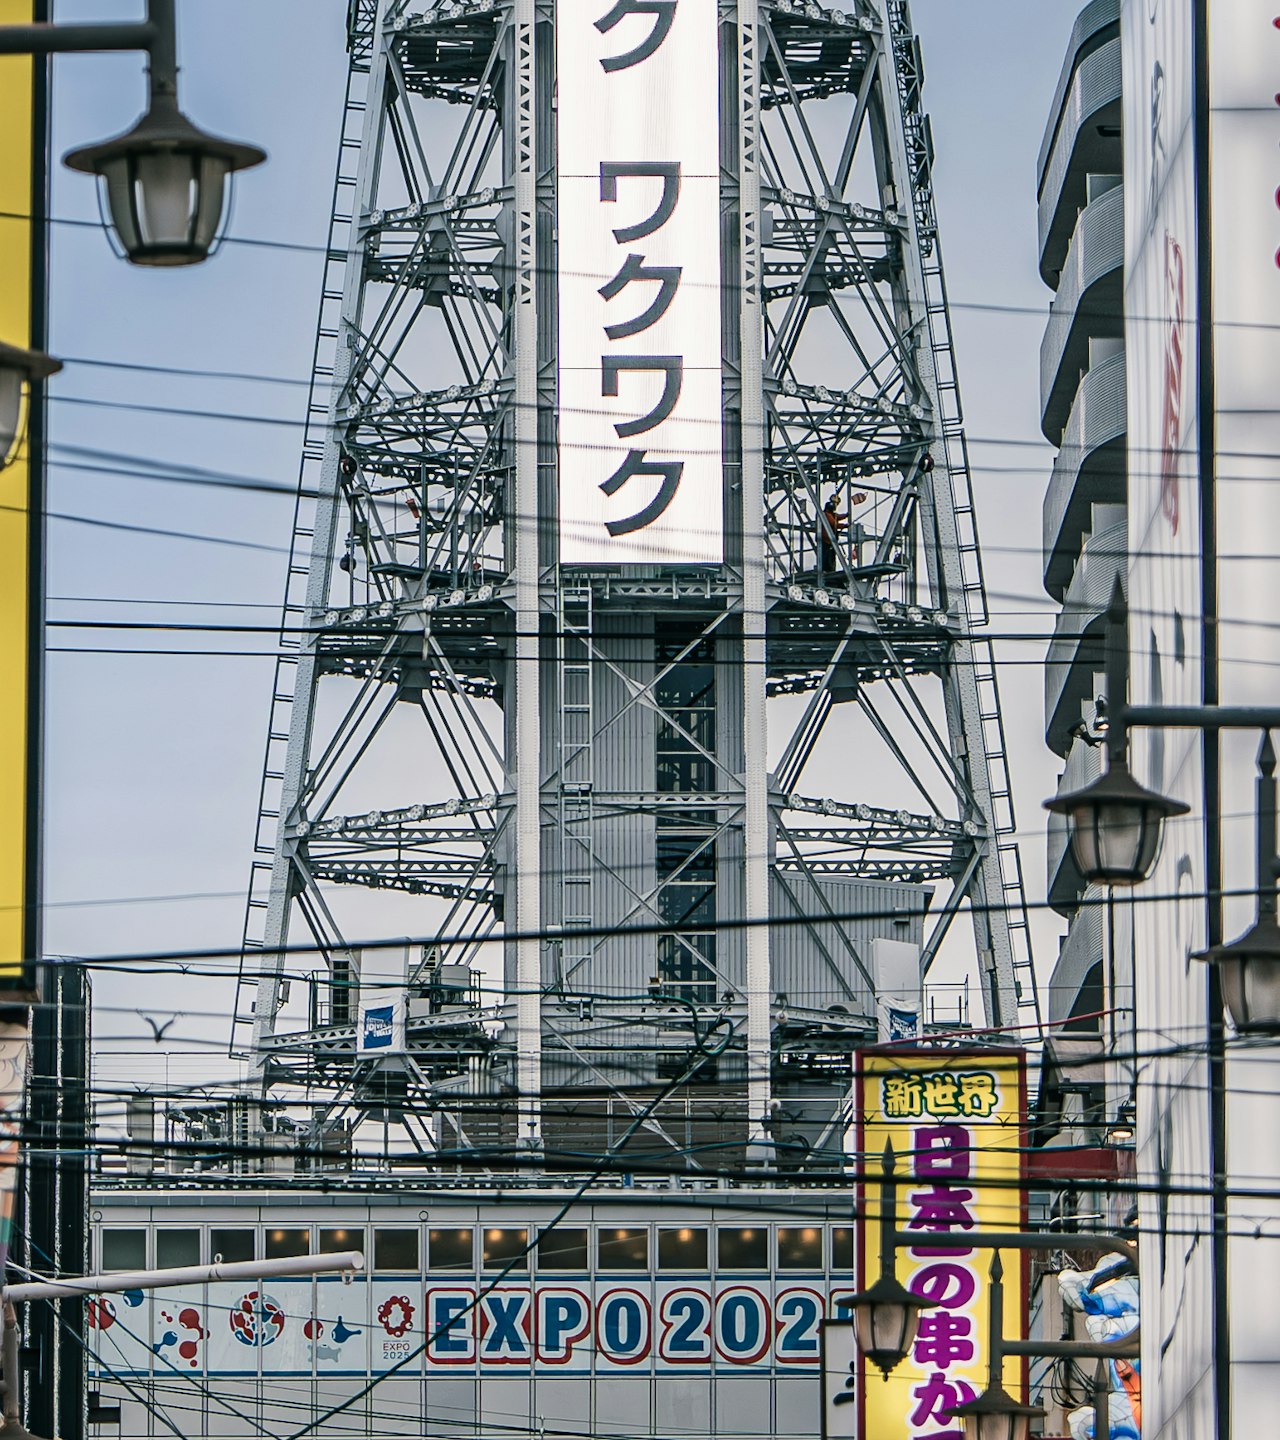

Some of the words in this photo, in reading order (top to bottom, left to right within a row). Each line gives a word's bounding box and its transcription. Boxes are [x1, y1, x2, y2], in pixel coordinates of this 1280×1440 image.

[594, 158, 683, 540] ワクワク
[884, 1074, 998, 1118] 新世界
[382, 1342, 410, 1351] EXPO
[430, 1292, 854, 1358] EXPO202
[382, 1351, 410, 1360] 2025
